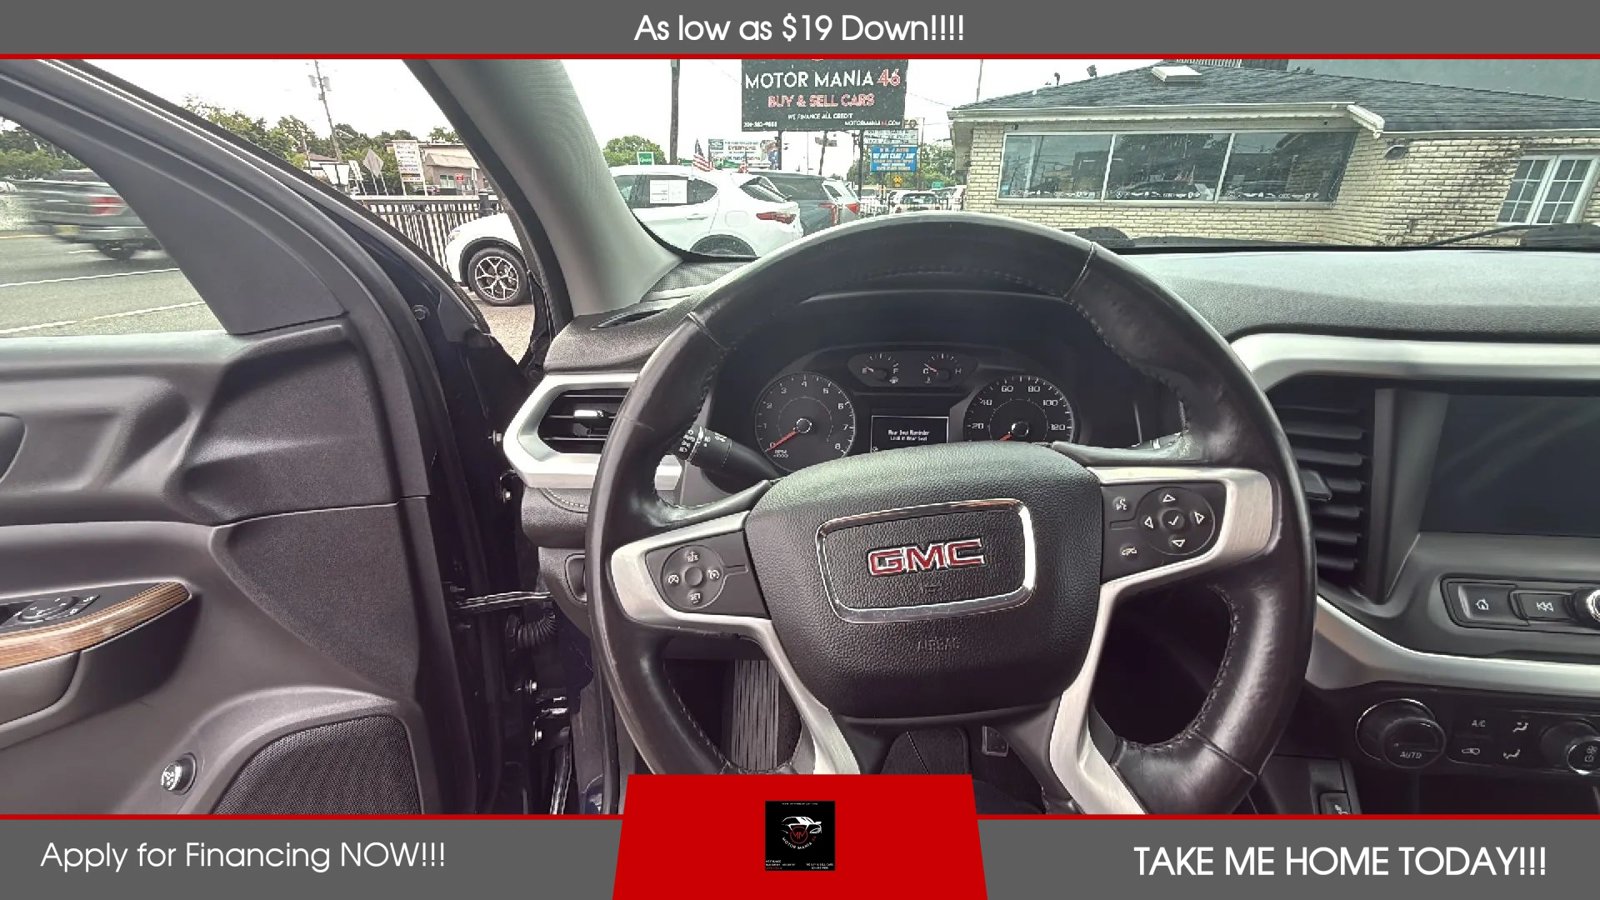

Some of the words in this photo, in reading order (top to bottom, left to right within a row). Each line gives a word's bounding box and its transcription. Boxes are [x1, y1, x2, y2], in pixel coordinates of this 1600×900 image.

[745, 71, 808, 89] MOTOR
[814, 69, 874, 88] MANIA
[877, 68, 901, 87] 46
[767, 95, 795, 108] BUY
[797, 95, 807, 107] &
[809, 94, 839, 107] SELL
[841, 93, 876, 107] CARS
[1001, 385, 1014, 393] 60
[1027, 385, 1041, 393] 80
[971, 422, 984, 430] 20
[1050, 423, 1066, 431] 120
[868, 537, 985, 576] GMC
[1471, 719, 1486, 728] A/C
[1400, 750, 1422, 759] AUTO
